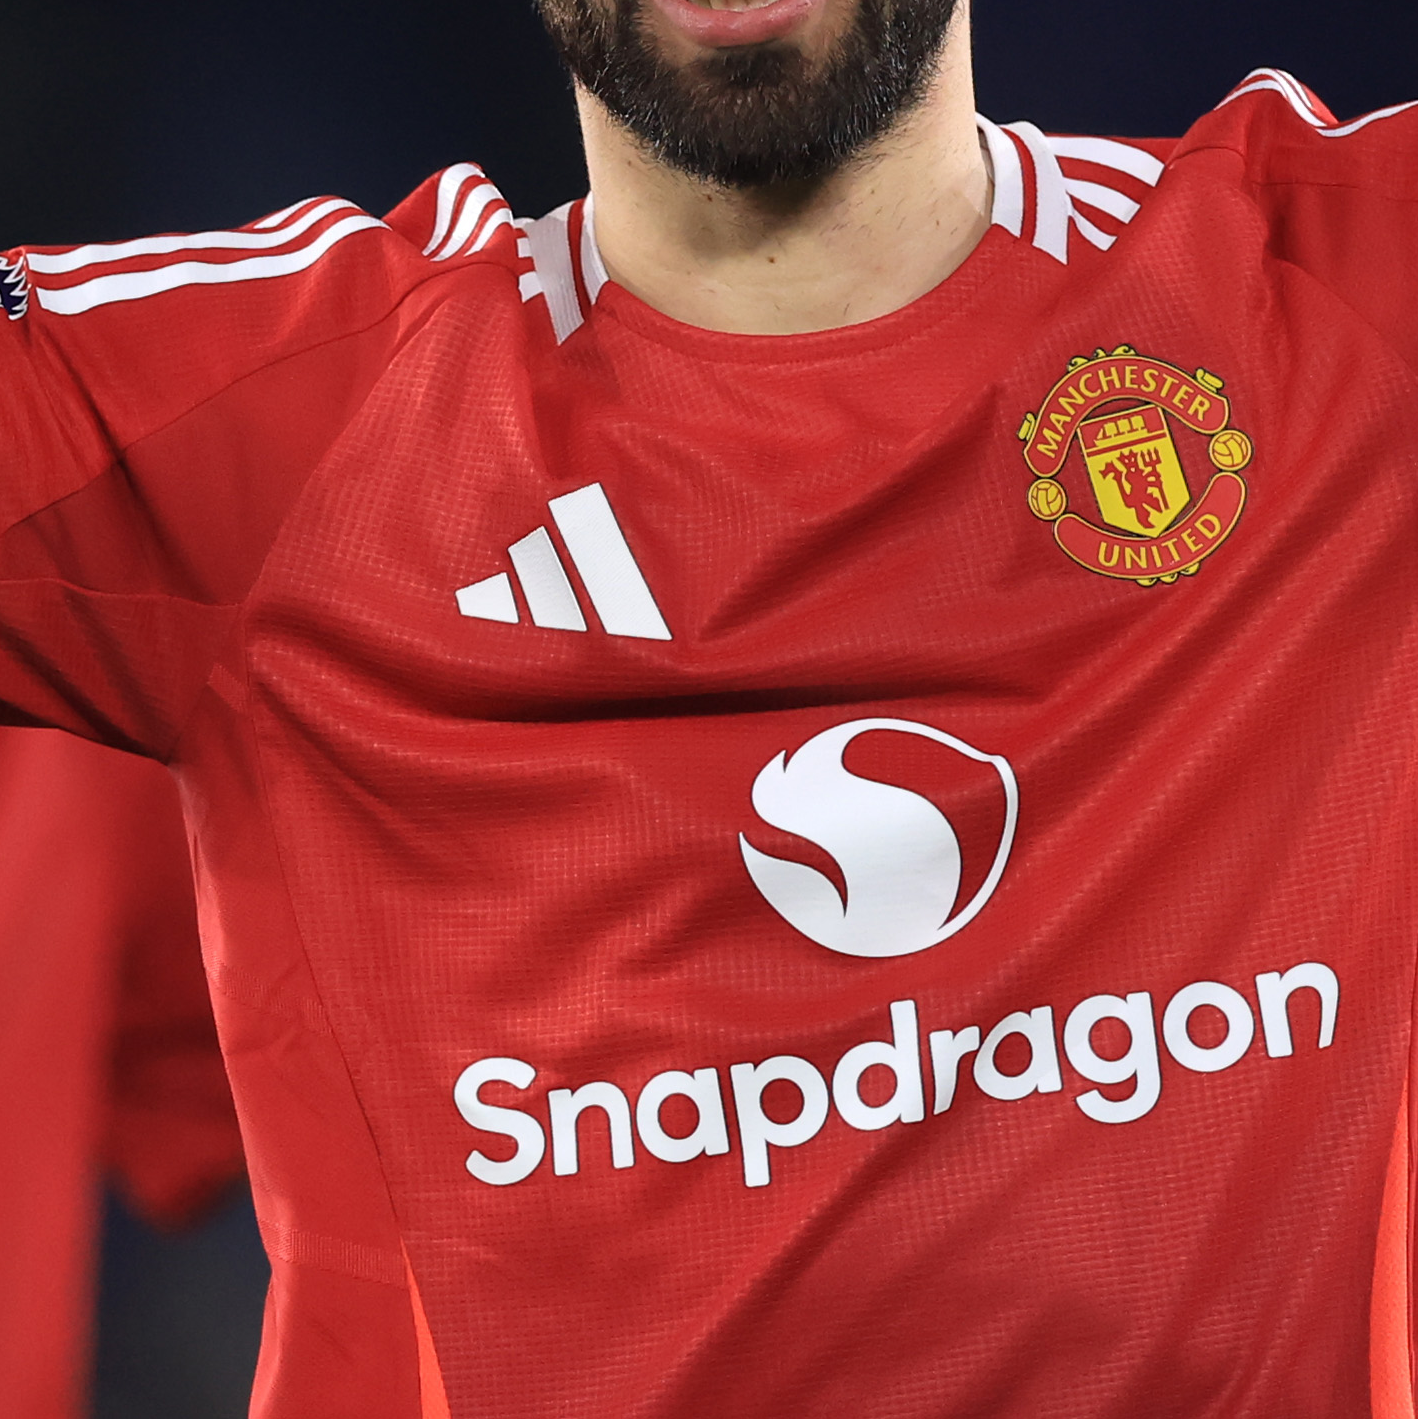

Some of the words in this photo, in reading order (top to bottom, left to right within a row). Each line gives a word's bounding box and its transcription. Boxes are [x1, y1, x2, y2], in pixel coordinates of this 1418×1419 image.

[1036, 366, 1211, 458] MANCHESTER
[1098, 513, 1222, 569] UNITED
[453, 962, 1340, 1188] Snapdragon
